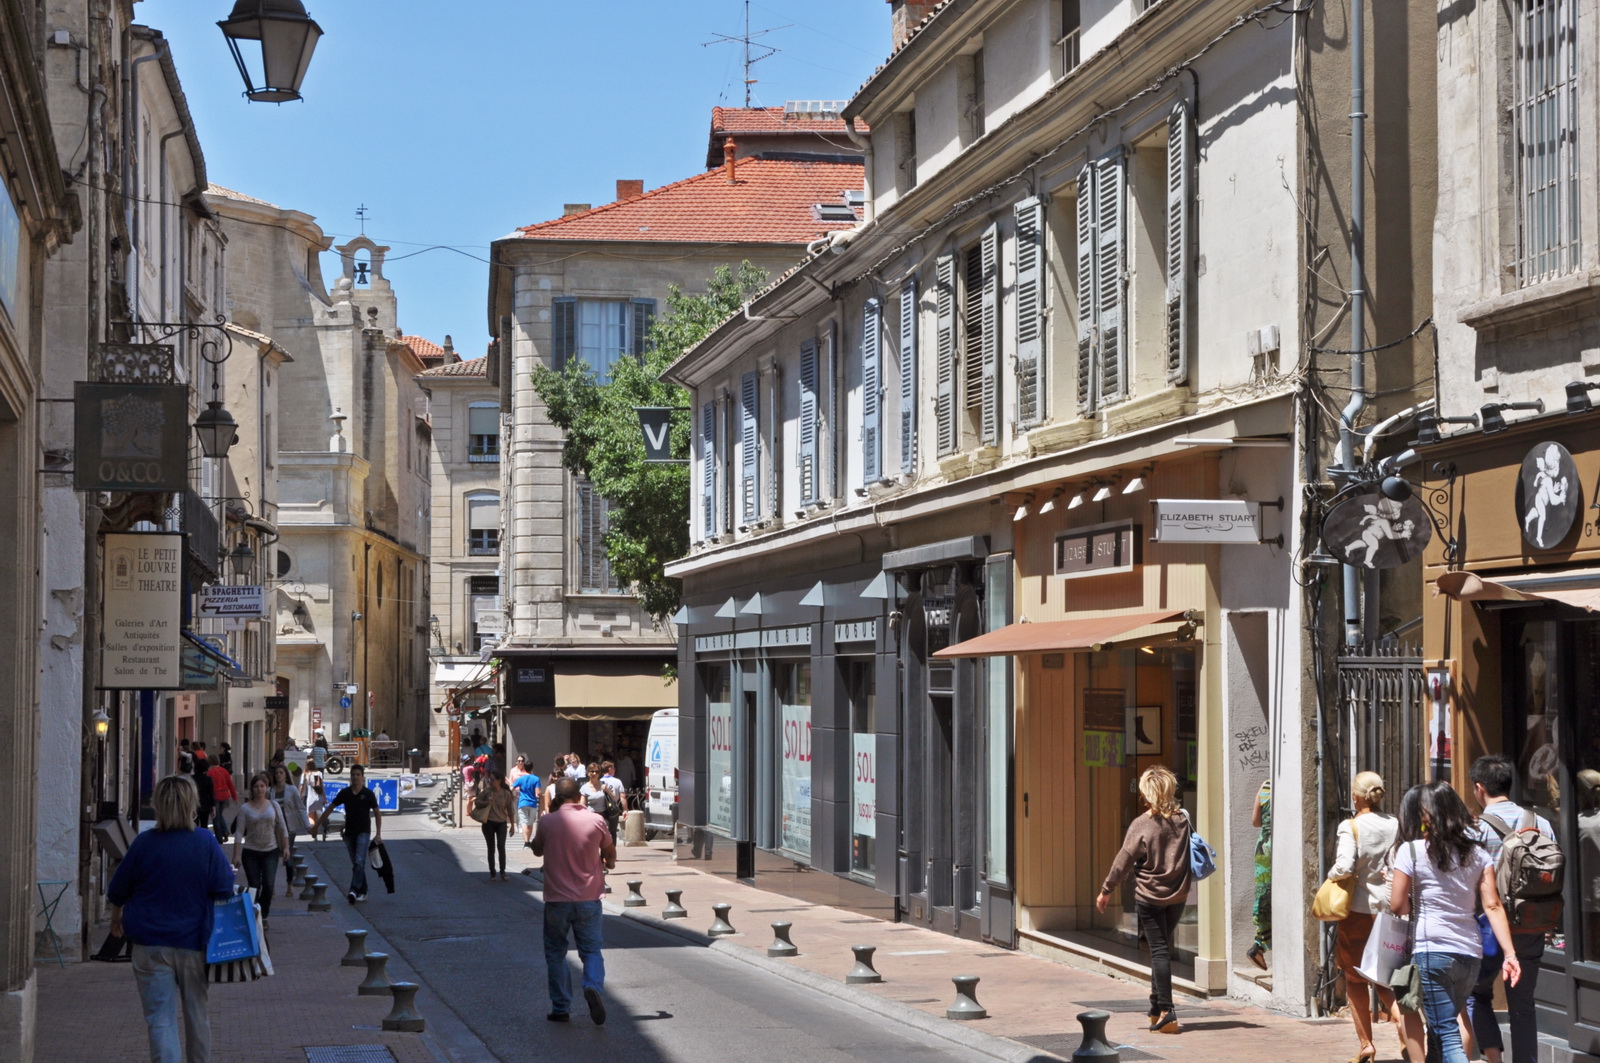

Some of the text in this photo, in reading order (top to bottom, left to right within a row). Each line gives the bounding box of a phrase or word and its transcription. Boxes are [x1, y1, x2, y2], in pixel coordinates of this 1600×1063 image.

[643, 422, 669, 451] V
[99, 461, 166, 483] O&CO.
[1160, 513, 1257, 522] ELIZABETH STUART
[138, 548, 177, 560] LE PETIT
[1058, 539, 1127, 565] LIZABEH STUAT
[138, 561, 177, 573] LOUVRE
[138, 579, 177, 592] THEATRE
[200, 588, 209, 596] LE
[212, 587, 255, 596] SPAGHETTI
[115, 619, 168, 628] Galeries d'Art
[124, 631, 160, 640] Antiquités
[765, 627, 810, 644] VOGUE
[837, 621, 875, 640] VOGUE
[106, 643, 175, 653] Salles d'exposition
[122, 655, 160, 664] Restaurant
[114, 666, 168, 675] Salon de Thé
[857, 752, 875, 784] SOL
